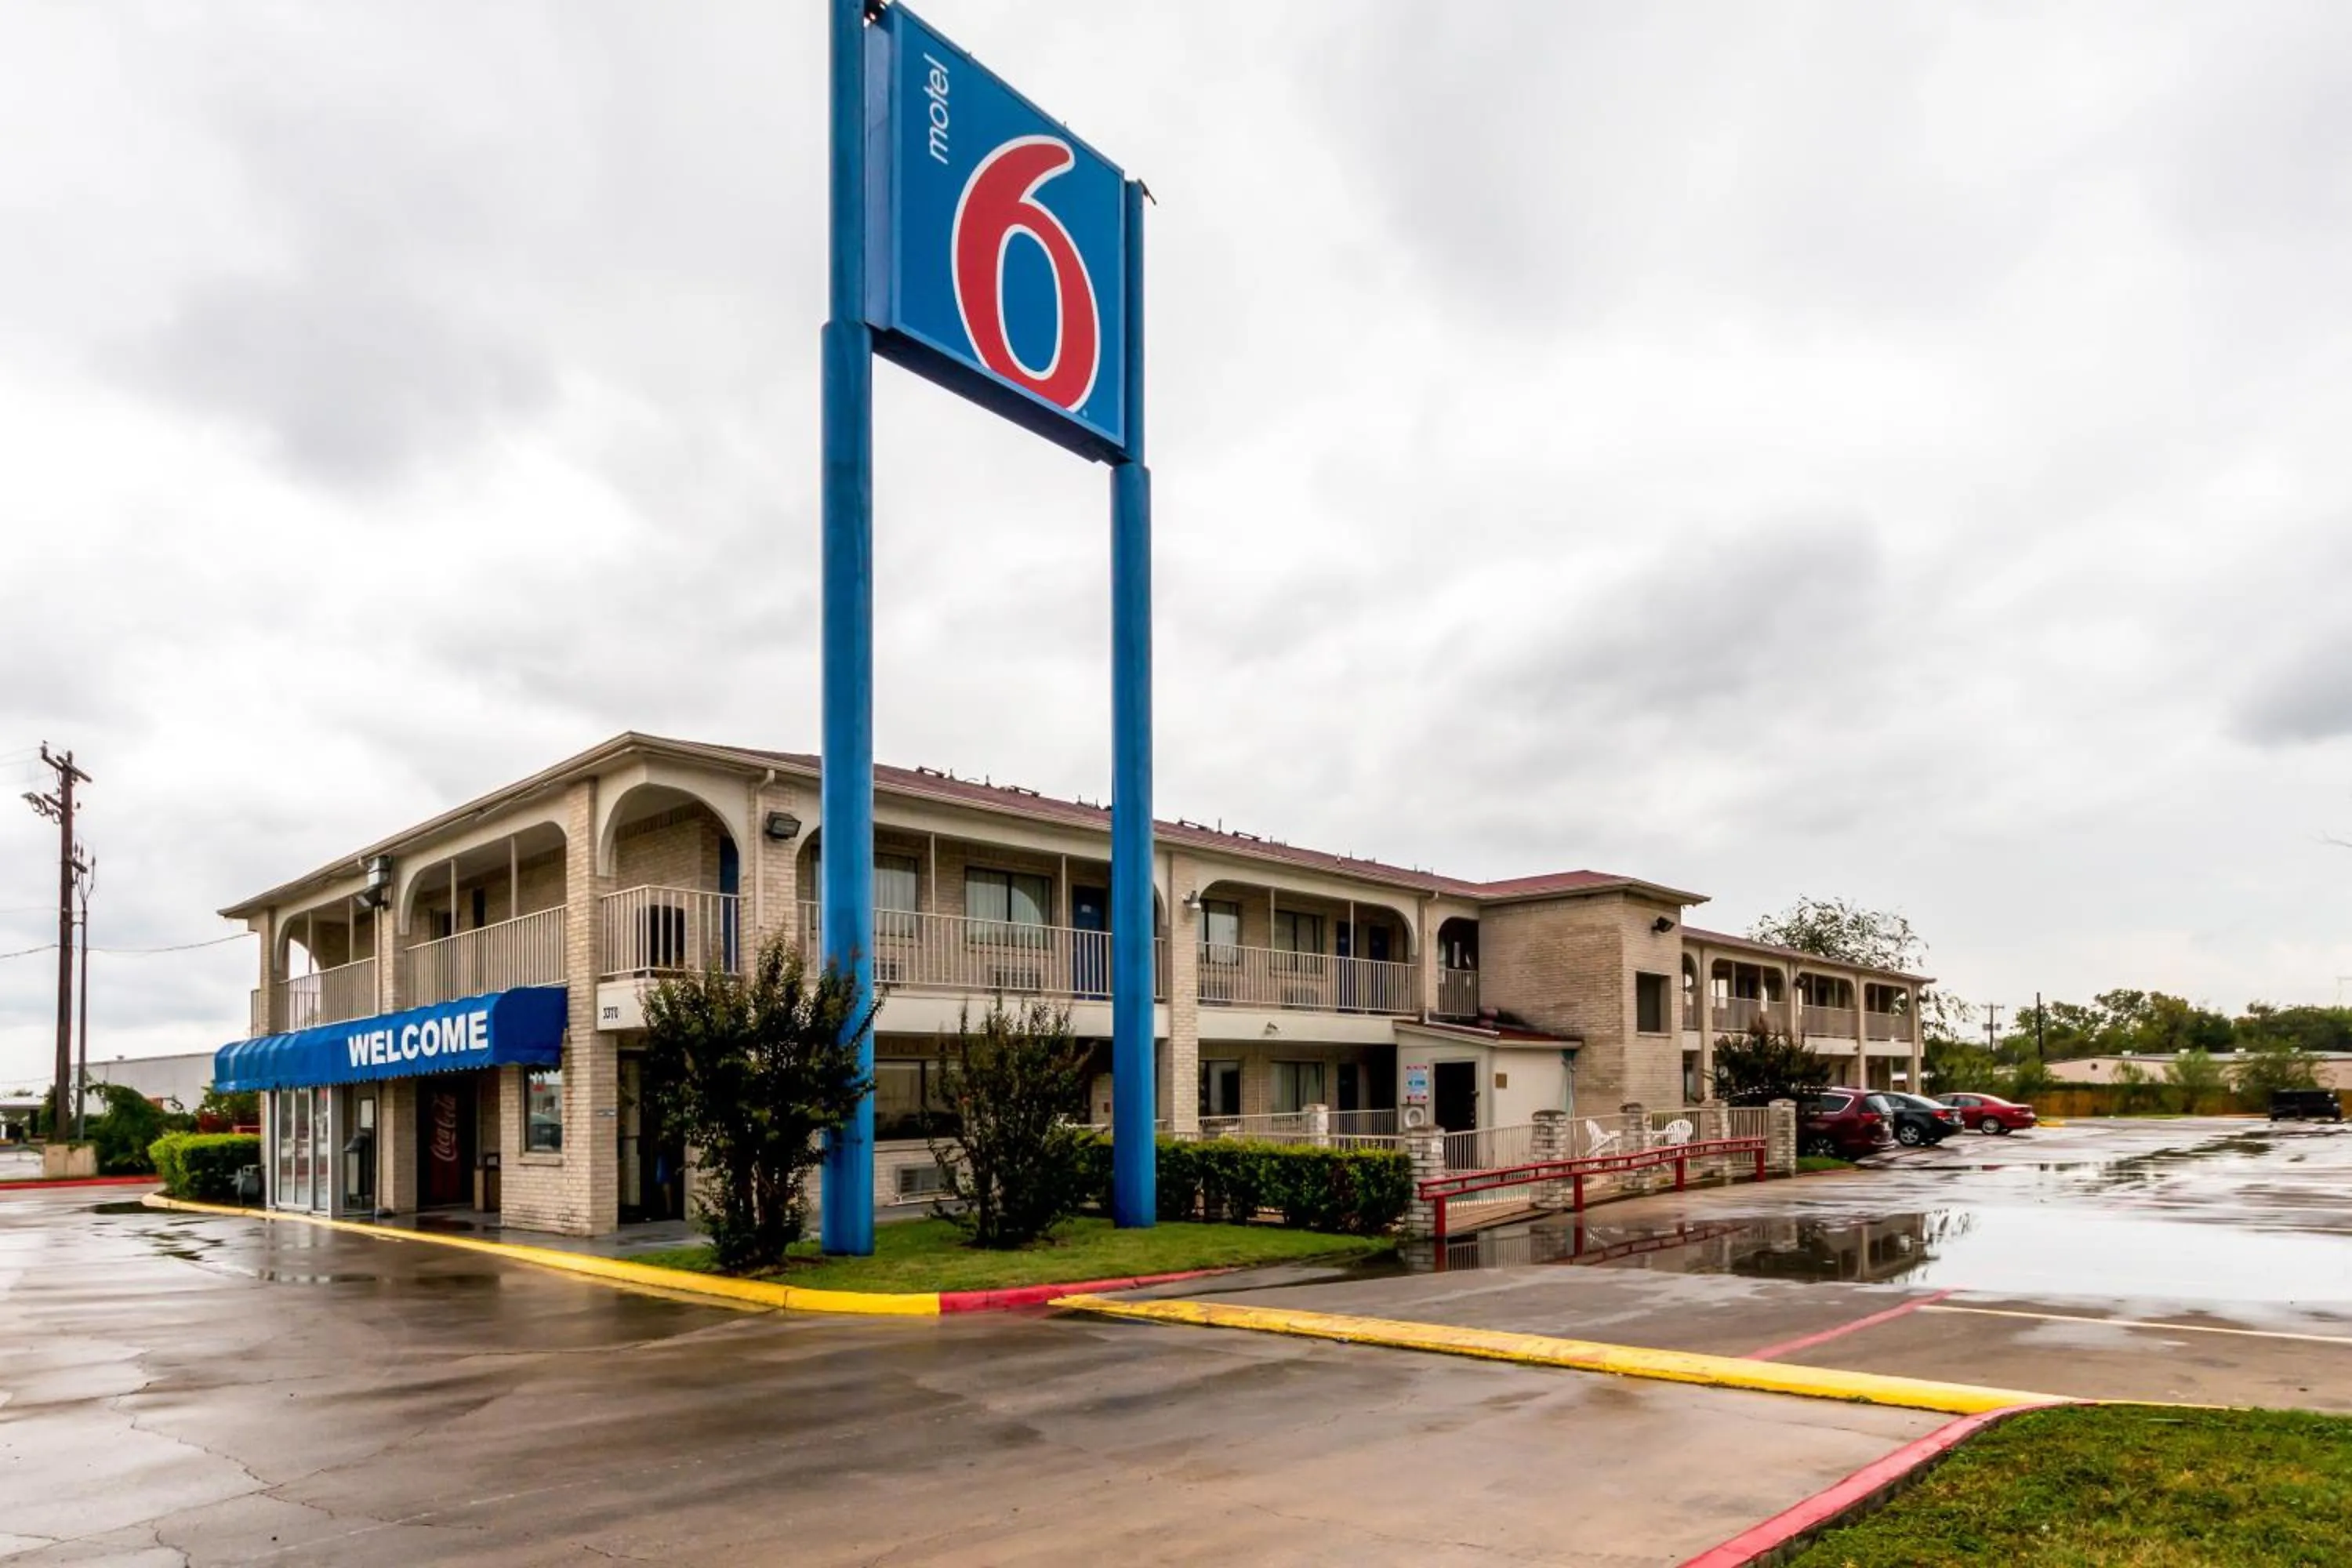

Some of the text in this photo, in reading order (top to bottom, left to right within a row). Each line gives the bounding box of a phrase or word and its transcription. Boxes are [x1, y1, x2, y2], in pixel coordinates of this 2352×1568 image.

[924, 53, 949, 165] motel
[951, 134, 1101, 412] 6
[348, 1011, 488, 1067] WELCOME
